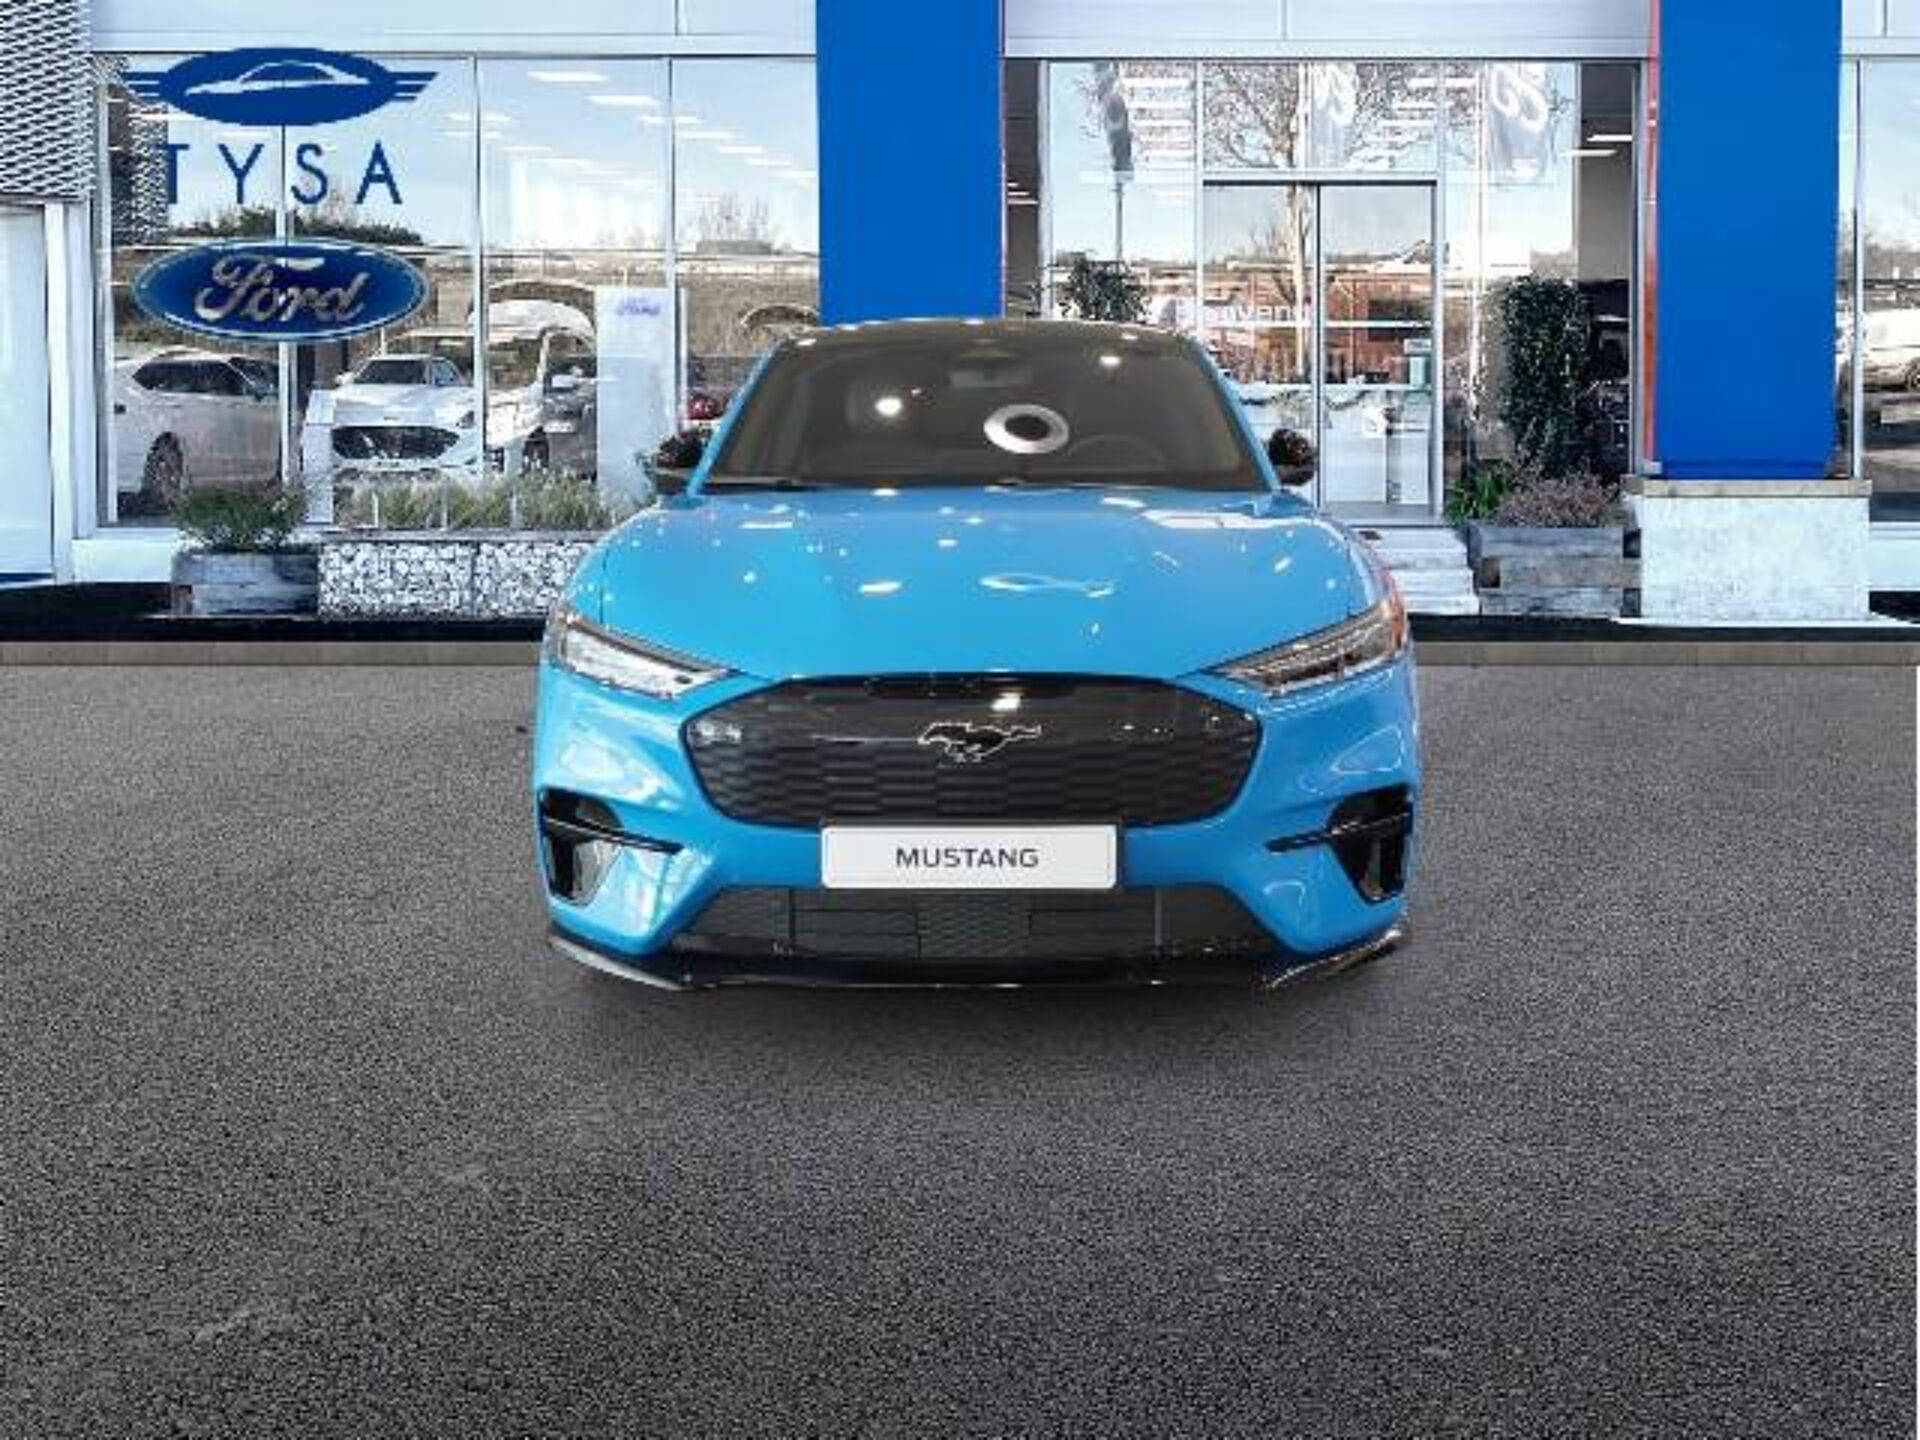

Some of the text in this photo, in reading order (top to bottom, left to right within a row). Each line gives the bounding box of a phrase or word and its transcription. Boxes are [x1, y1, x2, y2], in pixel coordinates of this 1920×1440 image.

[157, 138, 403, 204] TYSA
[194, 254, 371, 322] Ford
[895, 847, 1040, 869] MUSTANG
